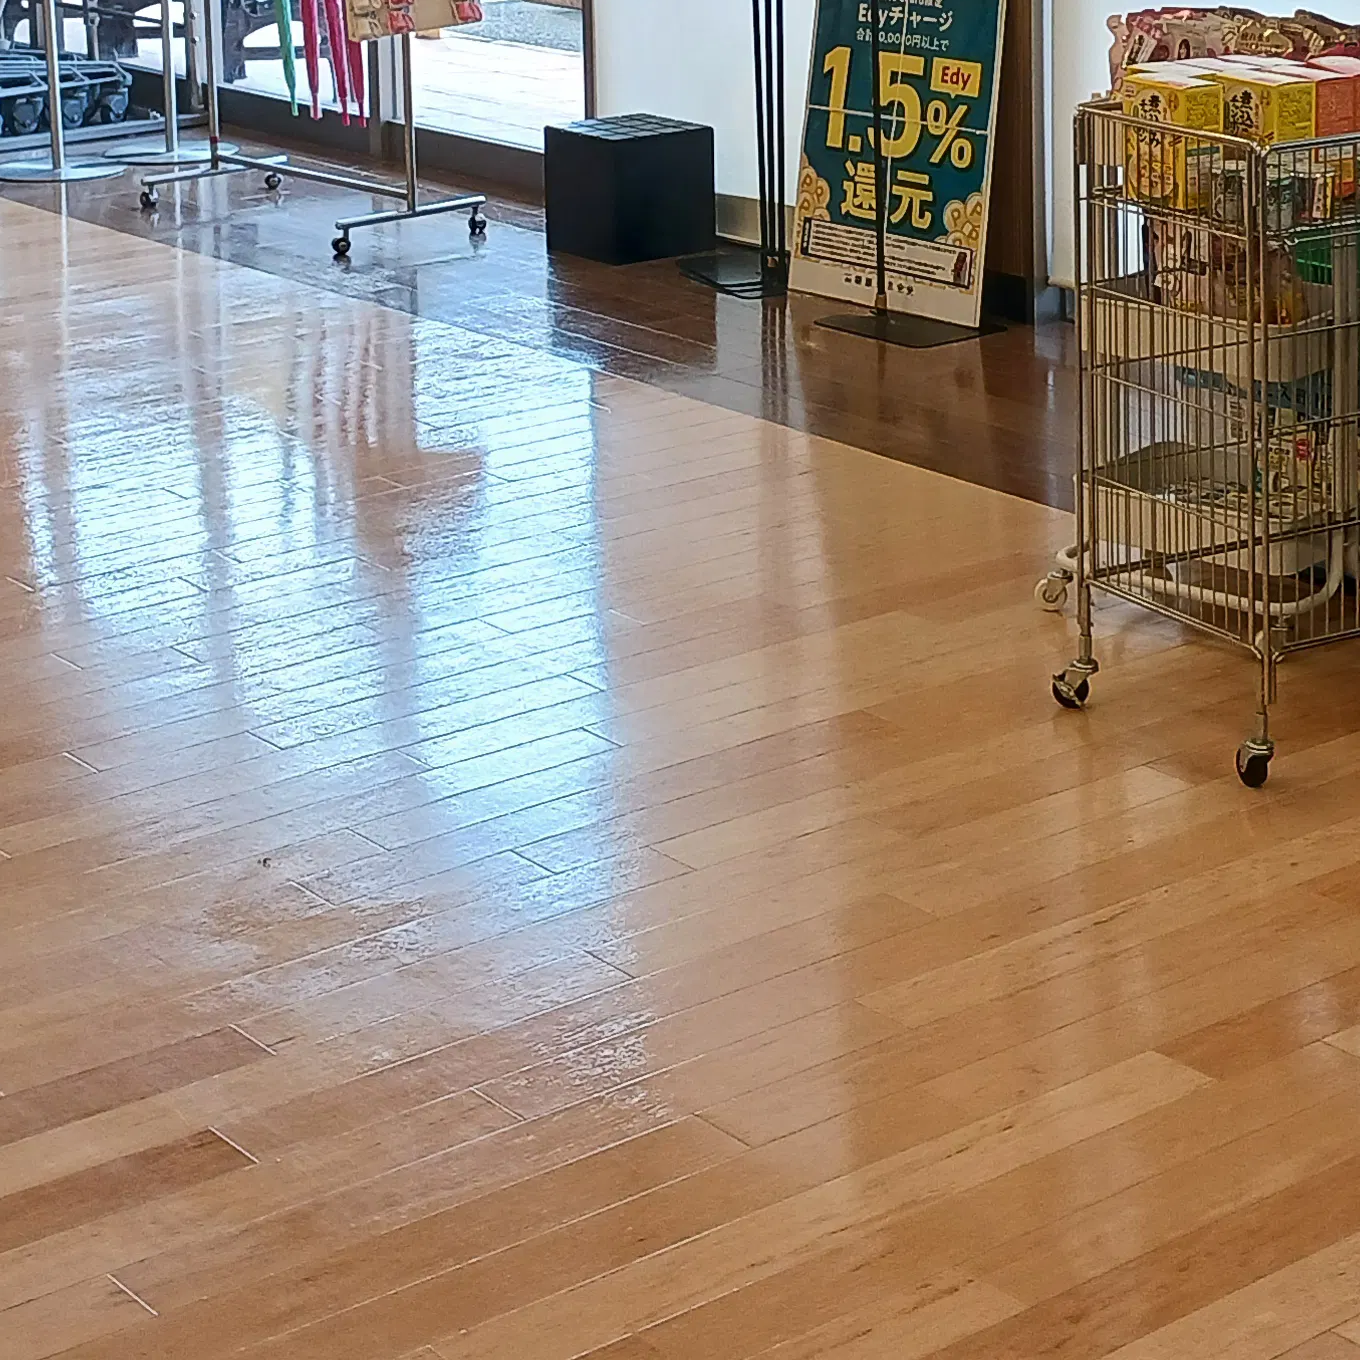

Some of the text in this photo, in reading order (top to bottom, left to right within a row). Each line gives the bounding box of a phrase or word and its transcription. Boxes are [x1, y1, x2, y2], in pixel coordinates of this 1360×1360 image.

[858, 3, 954, 32] Eyチャージ
[940, 65, 972, 91] Edy
[840, 159, 934, 230] 還元
